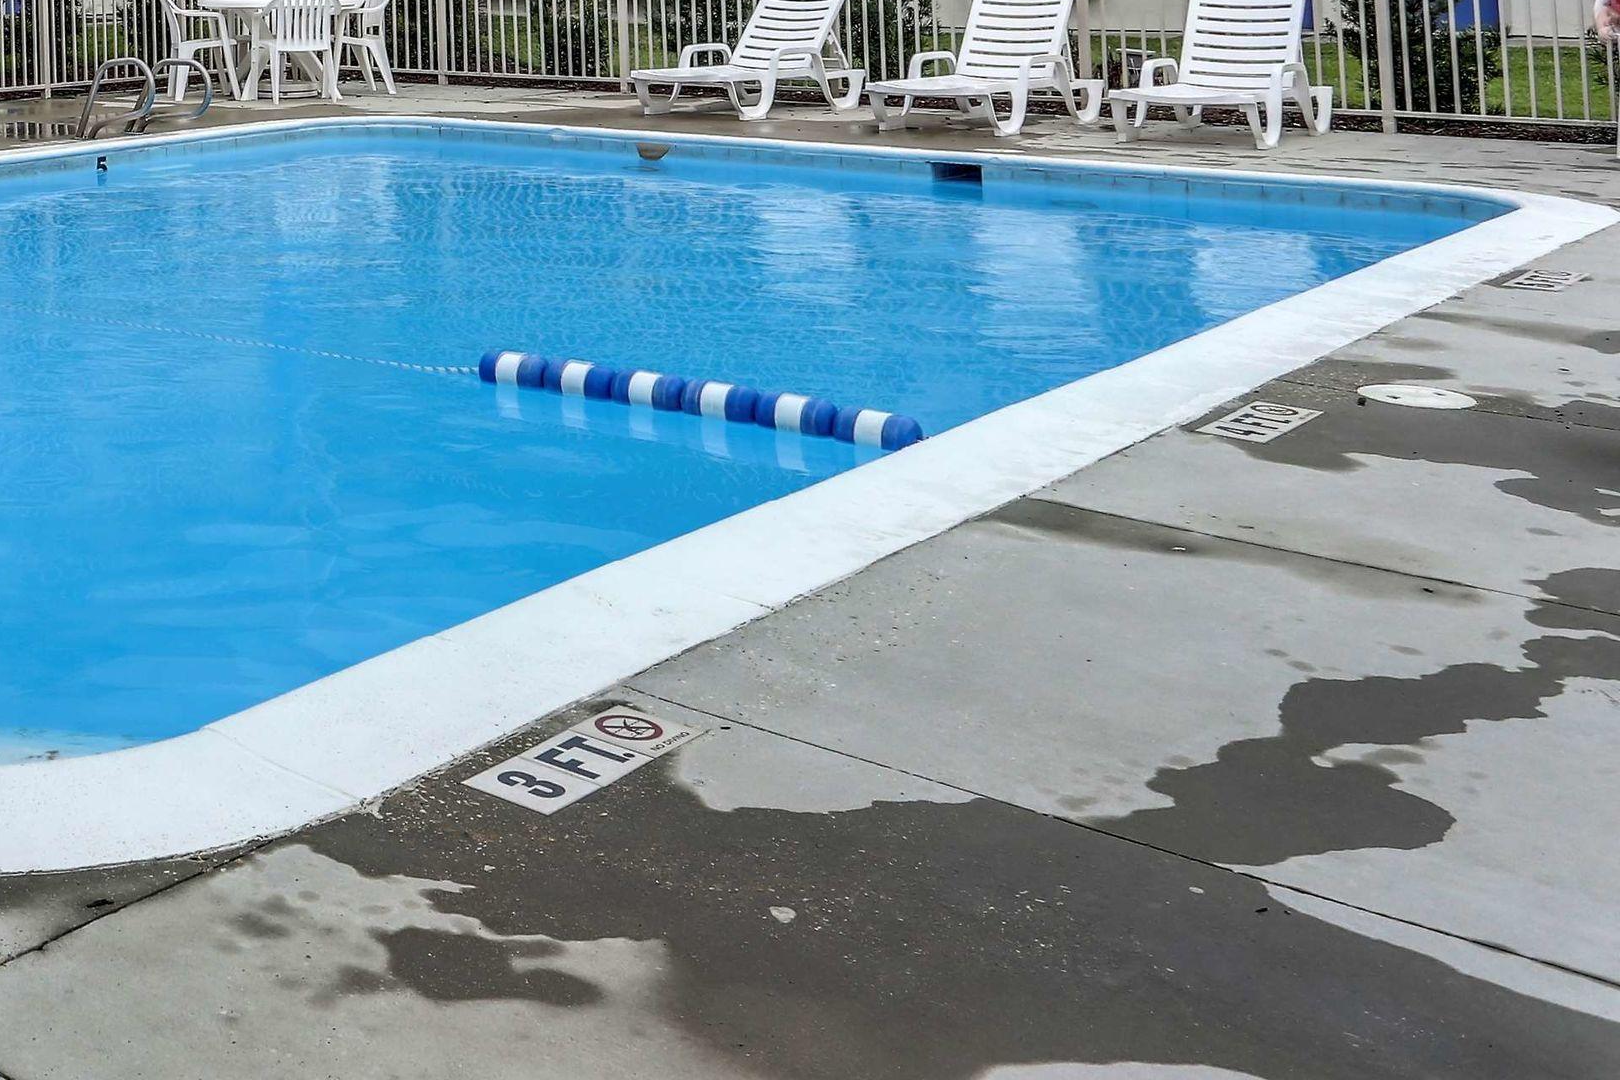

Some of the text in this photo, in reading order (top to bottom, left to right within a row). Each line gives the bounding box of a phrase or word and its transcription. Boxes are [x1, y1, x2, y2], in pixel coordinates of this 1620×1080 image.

[1215, 425, 1267, 436] 4
[496, 735, 636, 799] 3 FT.
